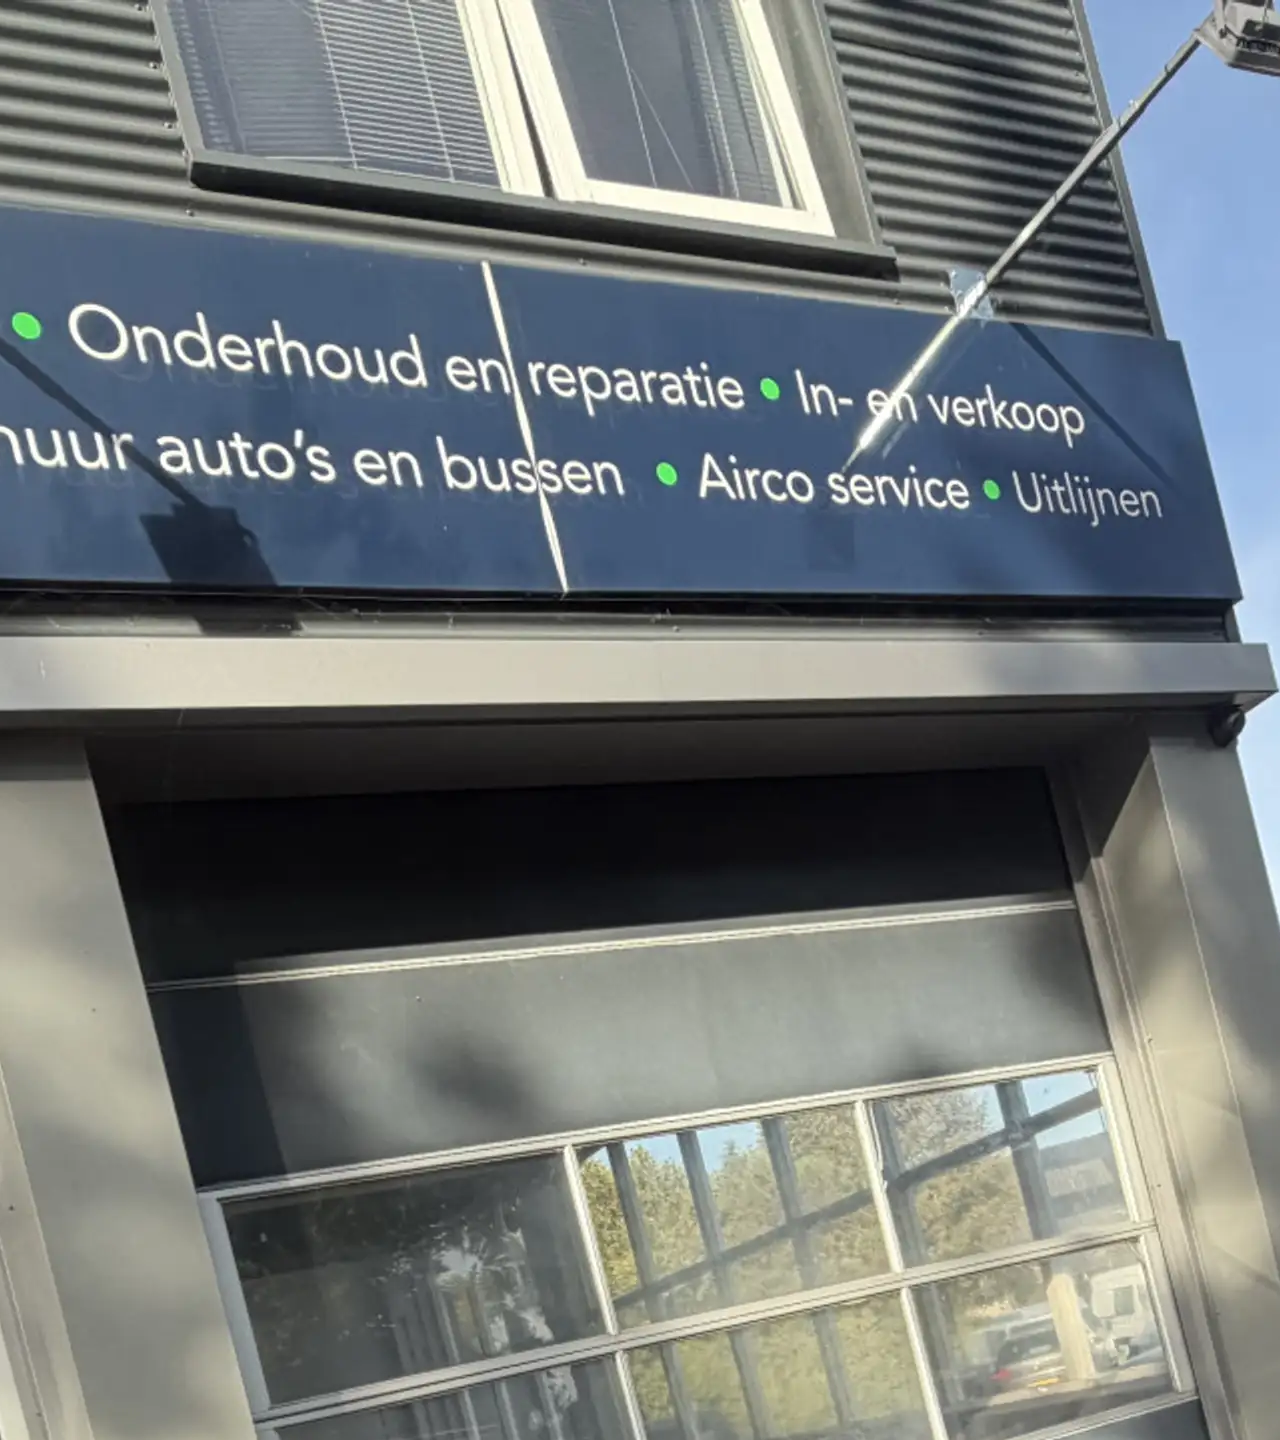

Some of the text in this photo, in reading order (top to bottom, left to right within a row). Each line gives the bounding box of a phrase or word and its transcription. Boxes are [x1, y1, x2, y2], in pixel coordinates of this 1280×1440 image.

[67, 303, 428, 389] Onderhoud
[445, 355, 511, 395] en
[527, 361, 745, 417] reparatie
[795, 369, 853, 417] In-
[866, 389, 918, 424] en
[927, 384, 1085, 448] verkoop
[156, 429, 336, 483] auto's
[352, 443, 423, 488] en
[435, 435, 625, 496] bussen
[699, 452, 814, 504] Airco
[827, 464, 970, 510] service
[1012, 470, 1163, 527] Uitlijnen
